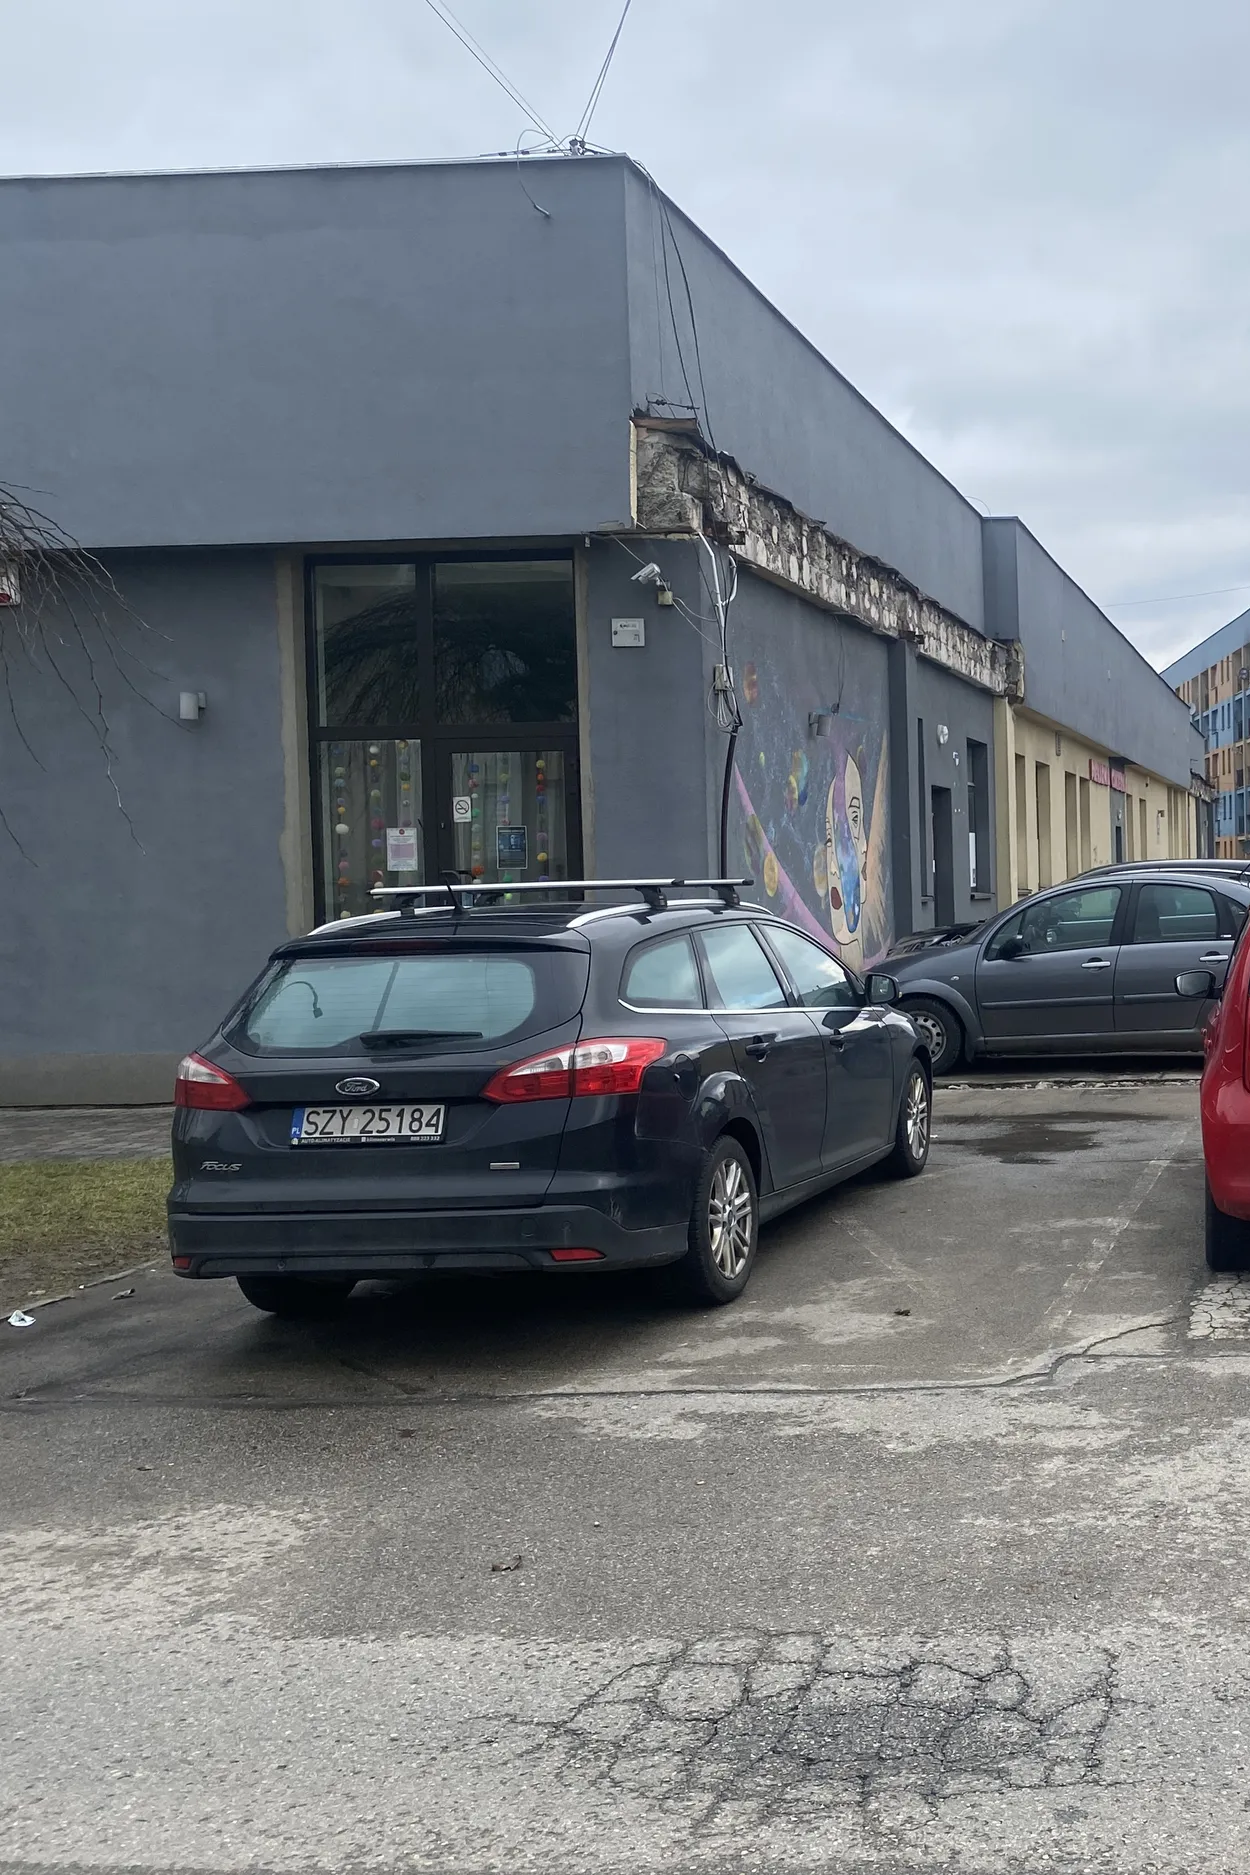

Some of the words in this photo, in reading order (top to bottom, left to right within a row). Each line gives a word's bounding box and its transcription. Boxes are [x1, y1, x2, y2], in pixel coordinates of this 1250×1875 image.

[344, 1081, 368, 1093] Ford
[304, 1109, 353, 1136] SZY
[359, 1107, 442, 1135] 25184
[291, 1127, 300, 1135] PL
[200, 1161, 242, 1171] FOCUS
